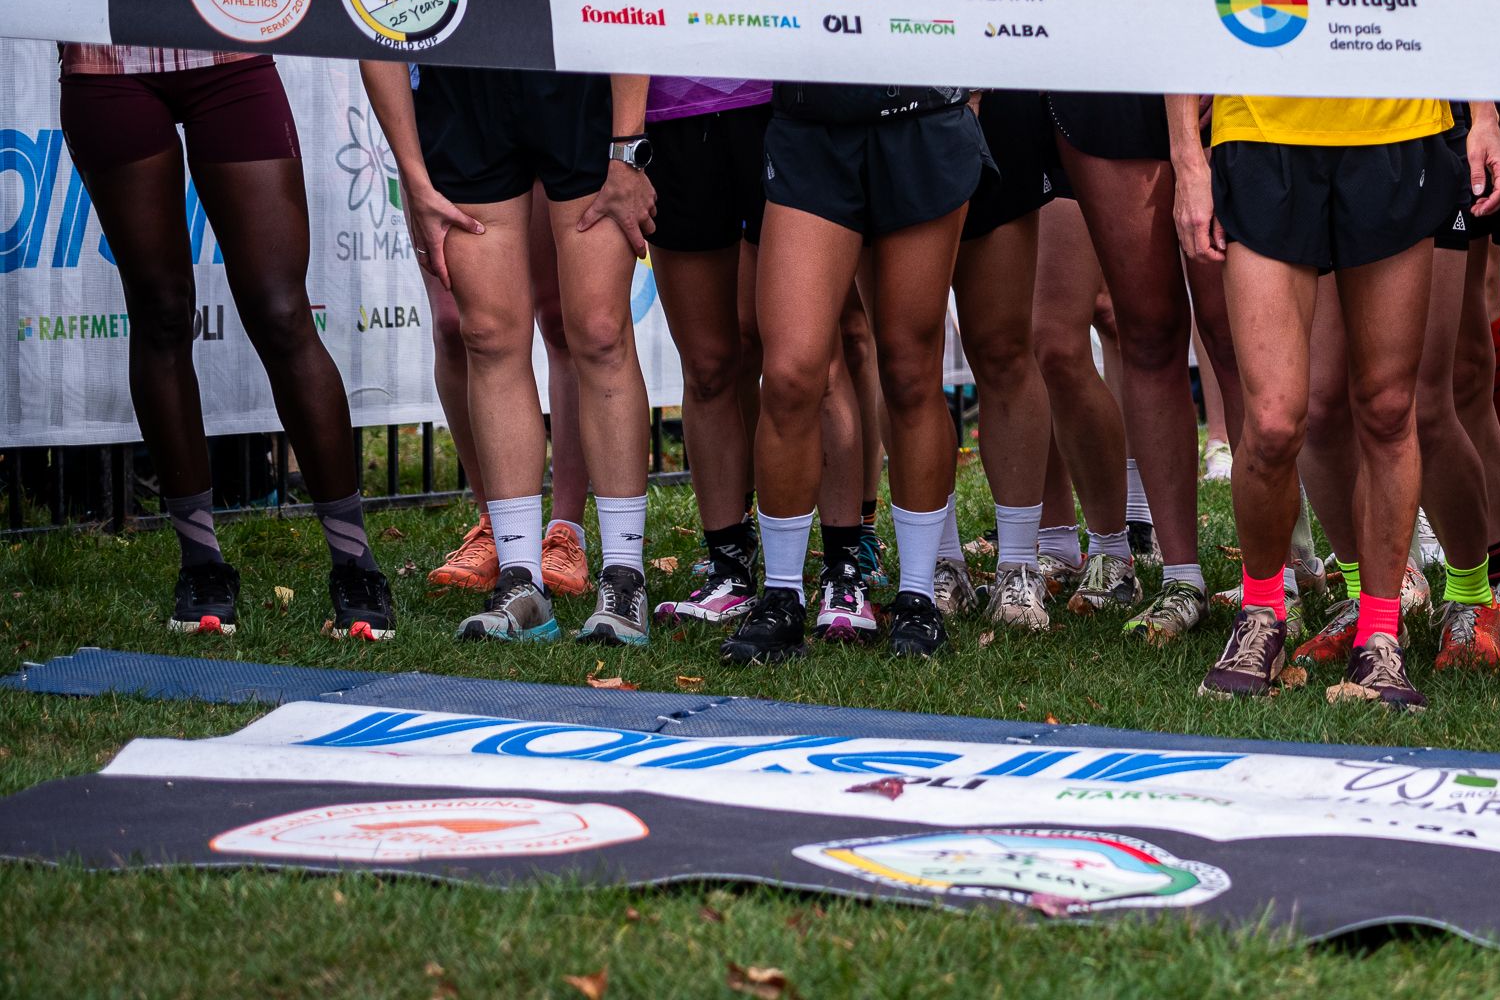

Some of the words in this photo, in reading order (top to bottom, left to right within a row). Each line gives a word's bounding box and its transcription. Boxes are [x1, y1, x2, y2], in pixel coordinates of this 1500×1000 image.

[260, 12, 293, 36] PERMIT
[389, 12, 408, 27] 25
[580, 5, 667, 27] fondital
[704, 13, 801, 29] RAFFMETAL
[822, 14, 863, 35] OLI
[890, 22, 955, 35] MARVON
[1328, 22, 1352, 34] Um
[1355, 22, 1381, 36] país
[375, 33, 414, 51] WORLD
[417, 35, 438, 49] CUP
[1330, 38, 1374, 50] dentro
[1376, 38, 1393, 50] do
[1395, 39, 1422, 51] País
[370, 306, 420, 329] ALBA
[39, 313, 129, 341] RAFFMET
